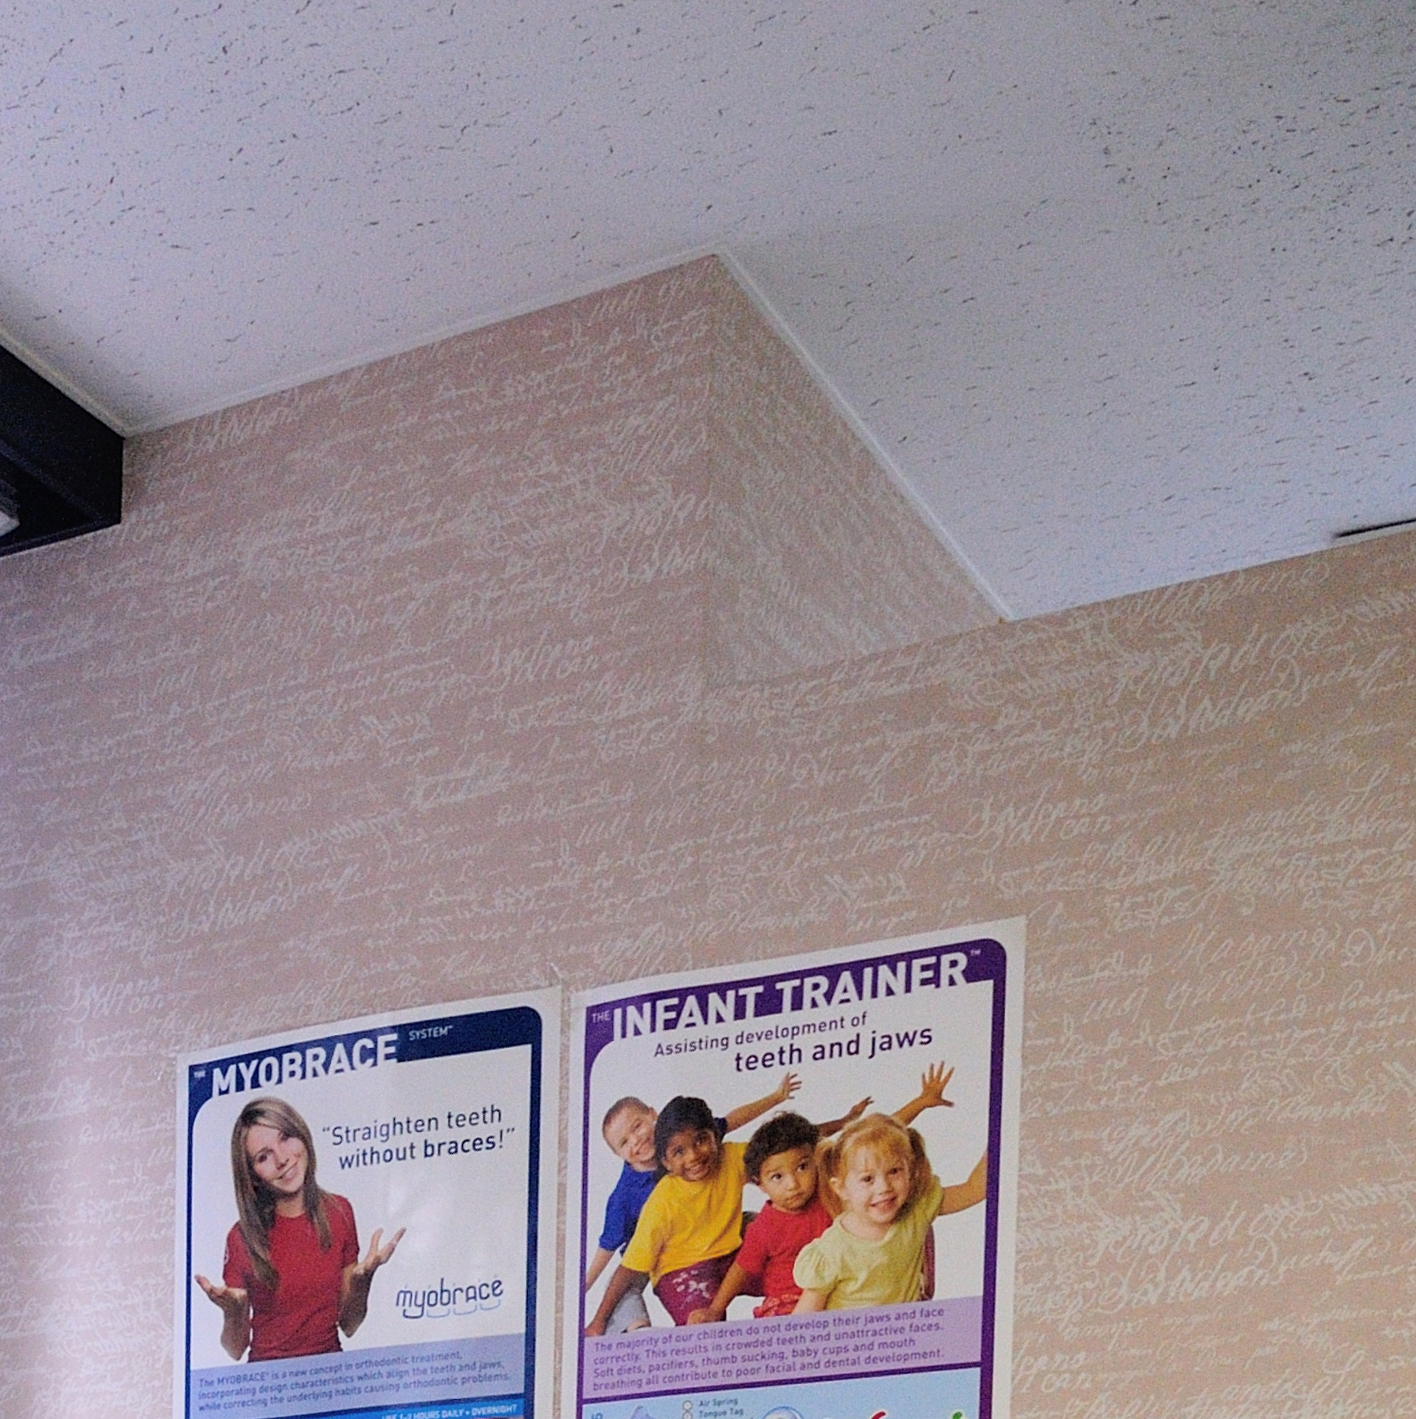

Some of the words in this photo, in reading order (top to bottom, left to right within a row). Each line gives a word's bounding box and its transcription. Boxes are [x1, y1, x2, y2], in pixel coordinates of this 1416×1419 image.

[591, 1010, 610, 1023] THE
[613, 986, 763, 1040] INFANT
[654, 1034, 729, 1058] Assisting
[734, 1017, 846, 1047] development
[851, 1012, 868, 1028] of
[734, 1045, 803, 1072] teeth
[812, 1033, 861, 1062] and
[868, 1027, 933, 1060] jaws
[211, 1033, 399, 1098] MYOBRACE
[446, 1104, 502, 1129] teeth
[339, 1139, 416, 1170] without
[395, 1277, 504, 1319] myobrace
[594, 1342, 613, 1351] The
[616, 1337, 659, 1350] majority
[662, 1334, 672, 1344] of
[675, 1333, 692, 1343] our
[697, 1328, 743, 1341] children
[746, 1326, 759, 1335] do
[763, 1323, 781, 1333] not
[785, 1320, 829, 1332] develop
[833, 1315, 860, 1326] their
[864, 1313, 891, 1325] jaws
[894, 1310, 916, 1321] and
[920, 1307, 944, 1318] face
[594, 1352, 639, 1365] correctly.
[645, 1349, 667, 1359] This
[670, 1344, 709, 1357] results
[712, 1344, 723, 1352] in
[726, 1337, 772, 1350] crowded
[776, 1333, 806, 1346] teeth
[809, 1333, 831, 1342] and
[834, 1325, 906, 1341] unattractive
[909, 1322, 943, 1333] faces.
[199, 1378, 214, 1387] The
[289, 1369, 307, 1378] new
[309, 1363, 343, 1377] concept
[355, 1356, 409, 1370] orthodontic
[412, 1351, 462, 1363] treatment,
[593, 1368, 614, 1378] Soft
[616, 1365, 645, 1375] diets,
[648, 1358, 698, 1373] pacifiers,
[701, 1356, 737, 1366] thumb
[741, 1349, 788, 1362] sucking,
[792, 1346, 818, 1359] baby
[822, 1344, 849, 1355] cups
[853, 1340, 874, 1351] and
[878, 1337, 916, 1349] mouth
[593, 1378, 643, 1391] breathing
[646, 1375, 659, 1385] all
[662, 1370, 718, 1383] contribute
[722, 1368, 733, 1377] to
[736, 1366, 762, 1378] poor
[766, 1362, 796, 1373] facial
[799, 1359, 820, 1370] and
[824, 1355, 861, 1368] dental
[864, 1349, 945, 1365] development.
[198, 1386, 256, 1401] incorporating
[259, 1382, 287, 1394] design
[290, 1375, 354, 1390] characteristics
[358, 1370, 383, 1382] which
[386, 1367, 409, 1380] align
[412, 1366, 427, 1375] the
[430, 1363, 456, 1374] teeth
[458, 1361, 476, 1371] and
[198, 1401, 221, 1412] while
[223, 1396, 267, 1410] correcting
[270, 1395, 284, 1405] the
[287, 1389, 333, 1403] underlying
[335, 1386, 362, 1397] habits
[364, 1382, 400, 1393] causing
[403, 1376, 458, 1389] orthodontic
[442, 1409, 464, 1418] DAILY
[472, 1404, 517, 1416] OVERNIGHT
[699, 1410, 727, 1419] Tongue
[730, 1408, 744, 1417] Tag
[712, 1399, 738, 1407] Spring
